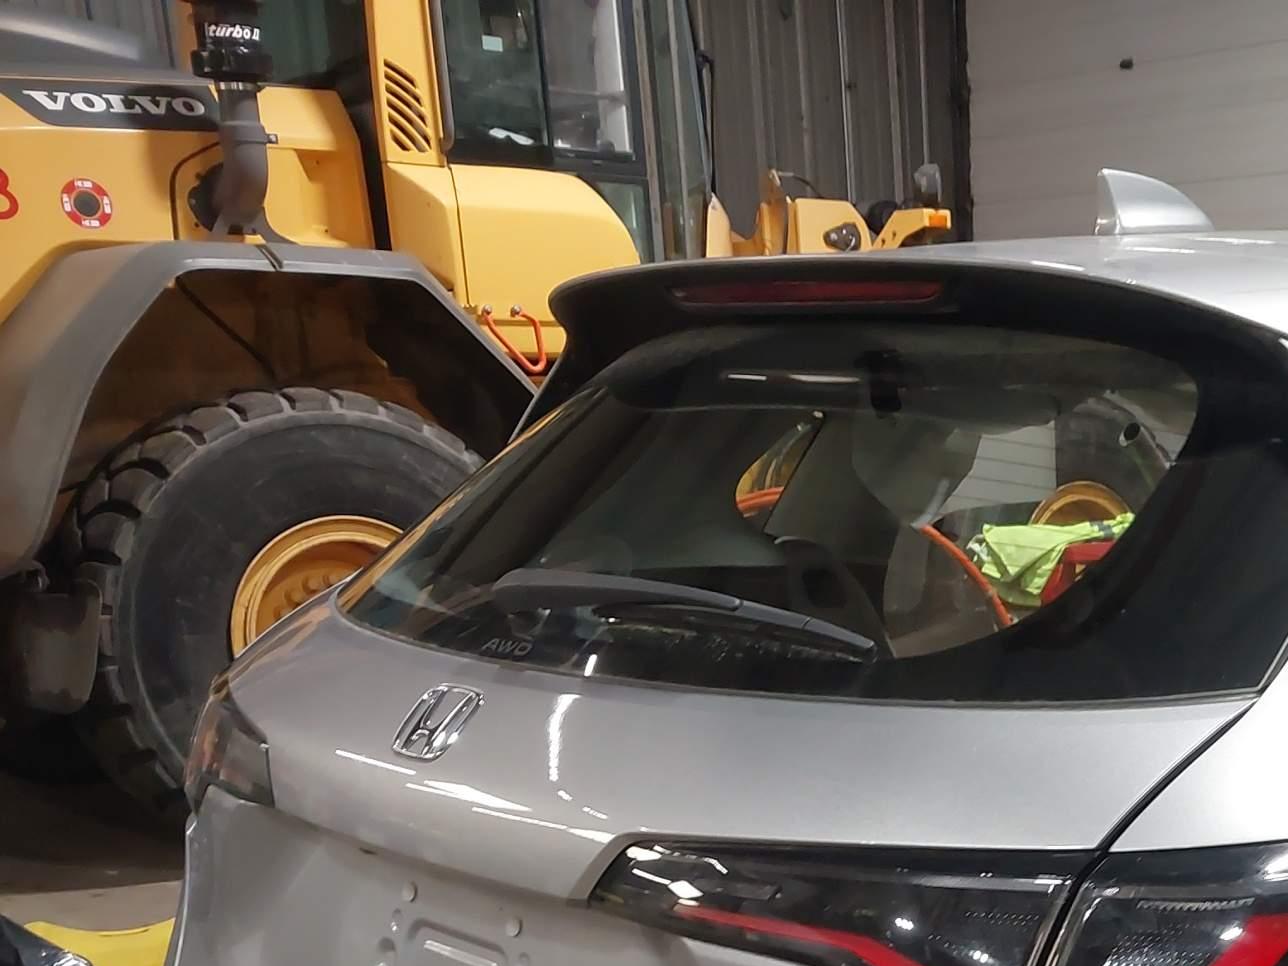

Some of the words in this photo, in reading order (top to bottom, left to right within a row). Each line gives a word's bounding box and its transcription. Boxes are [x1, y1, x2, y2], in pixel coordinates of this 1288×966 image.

[207, 24, 251, 39] turbo
[22, 89, 205, 116] VOLVO
[481, 638, 534, 657] AWD
